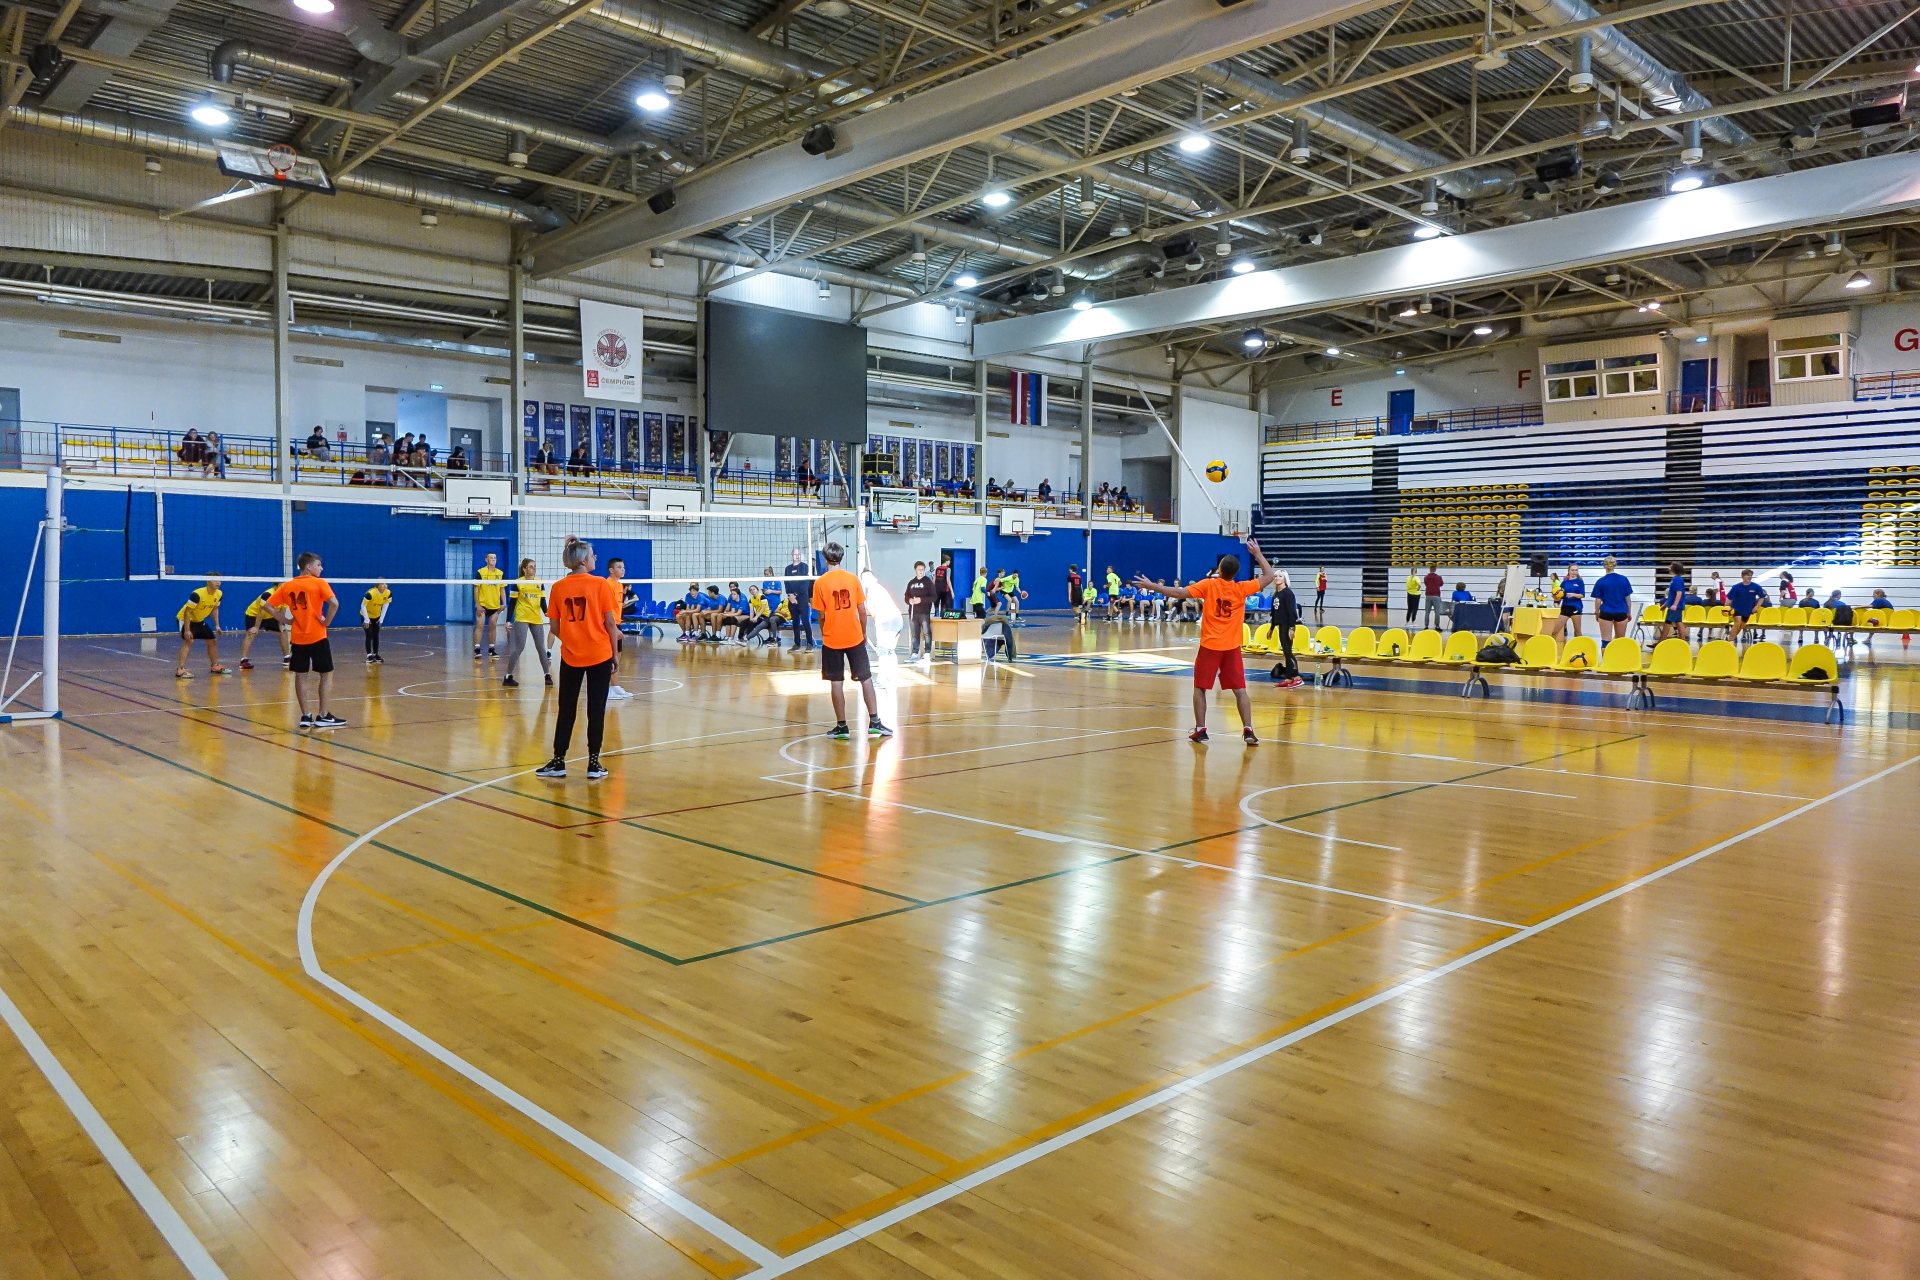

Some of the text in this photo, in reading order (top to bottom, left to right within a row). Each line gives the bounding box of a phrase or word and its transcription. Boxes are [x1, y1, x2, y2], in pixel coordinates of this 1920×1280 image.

[1894, 328, 1919, 352] G
[600, 377, 635, 386] ČEMPIONS
[1517, 369, 1532, 389] F
[1331, 389, 1343, 407] E
[289, 590, 308, 611] 14
[564, 596, 587, 622] 17
